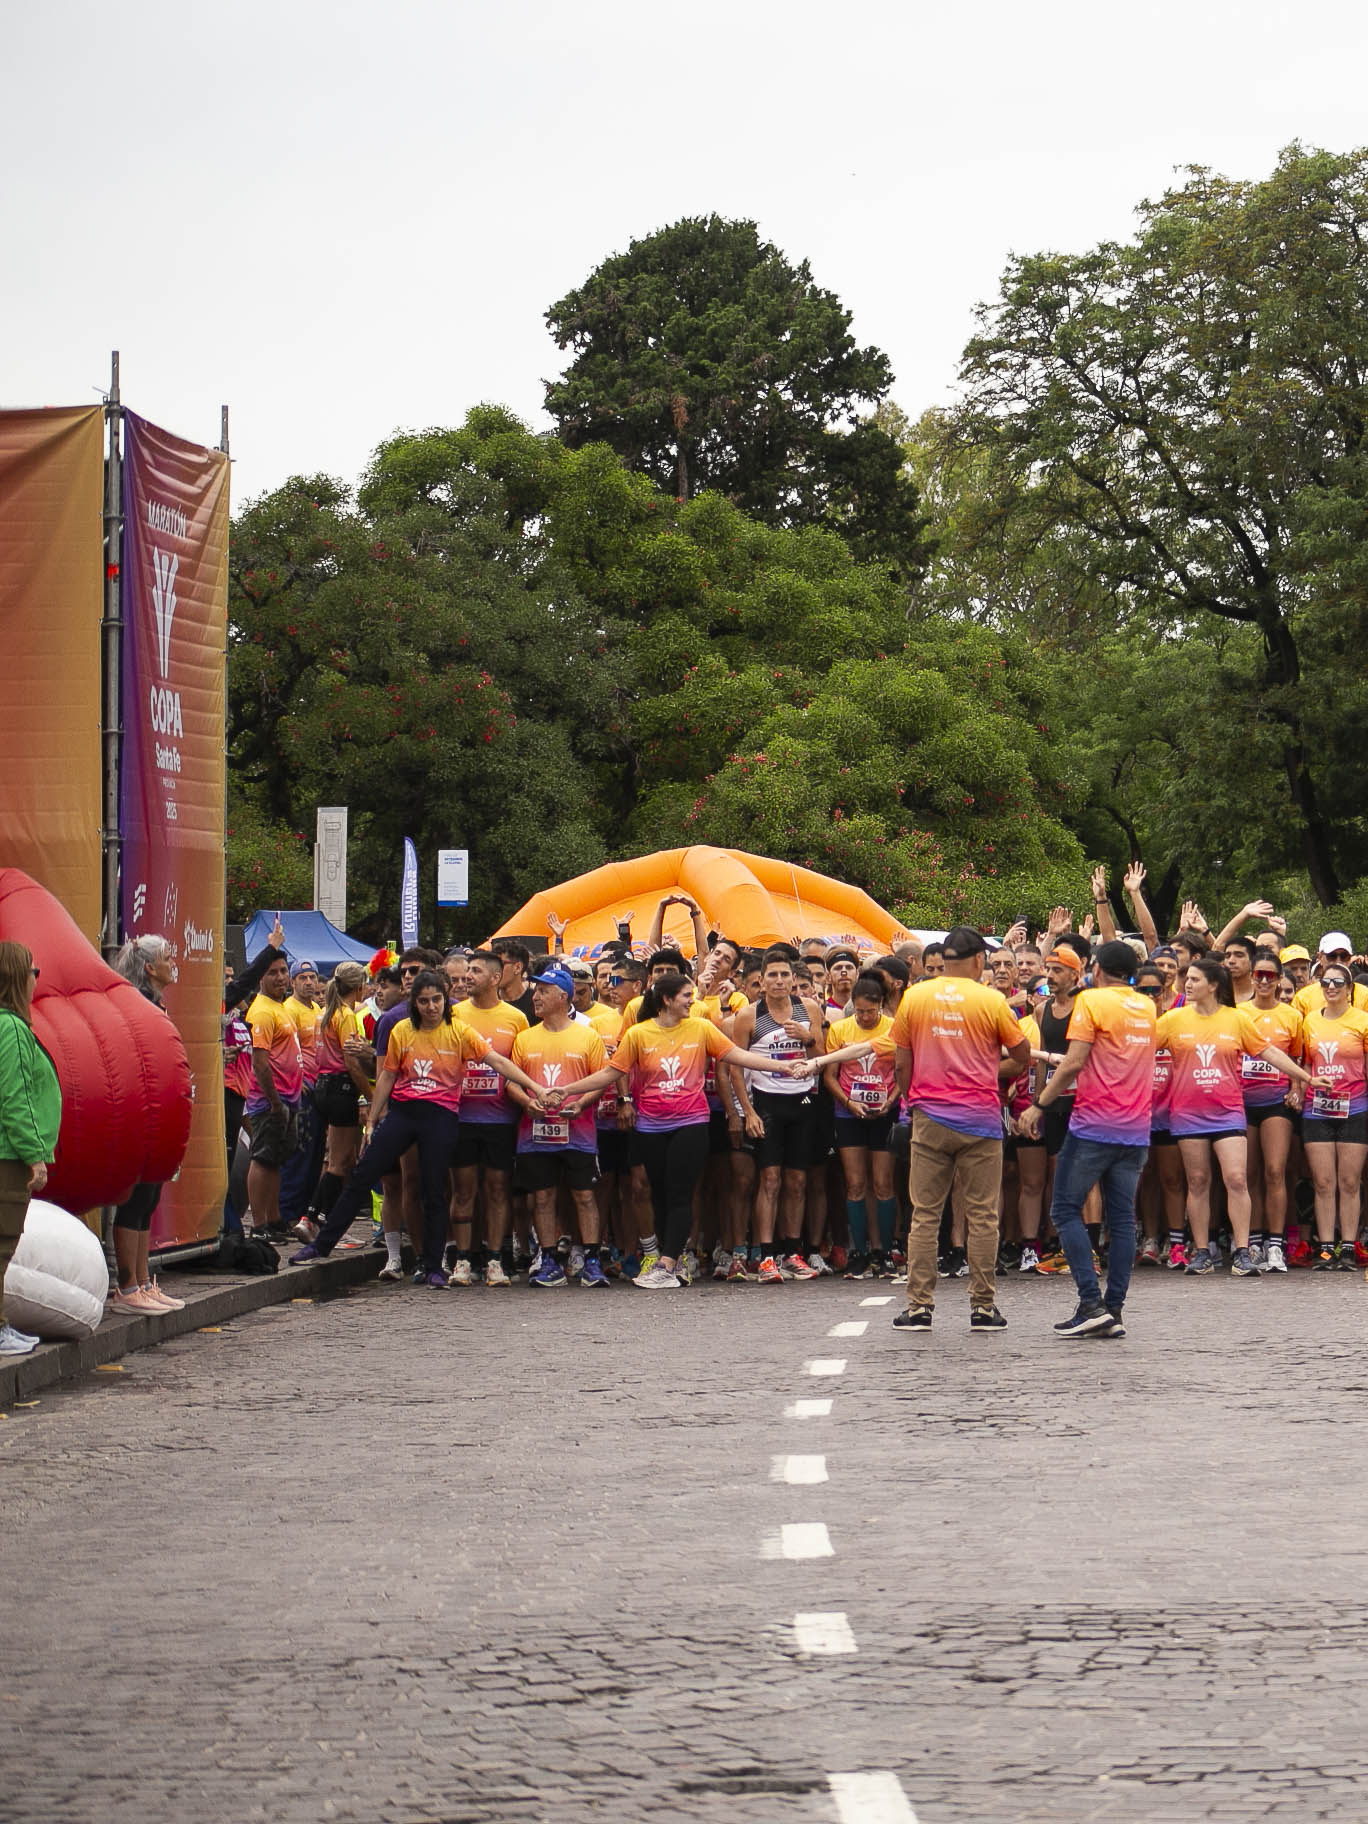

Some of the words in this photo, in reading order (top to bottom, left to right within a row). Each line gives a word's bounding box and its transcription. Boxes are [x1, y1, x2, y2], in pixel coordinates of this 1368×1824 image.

[147, 499, 187, 539] MARATÓN
[150, 685, 183, 739] COPA
[1250, 1062, 1272, 1073] 226
[1317, 1064, 1345, 1075] COPA
[1192, 1068, 1222, 1079] COPA
[466, 1078, 495, 1089] 5737
[658, 1078, 685, 1089] COPA
[859, 1091, 881, 1102] 169
[1321, 1099, 1341, 1110] 241
[540, 1124, 561, 1136] 139
